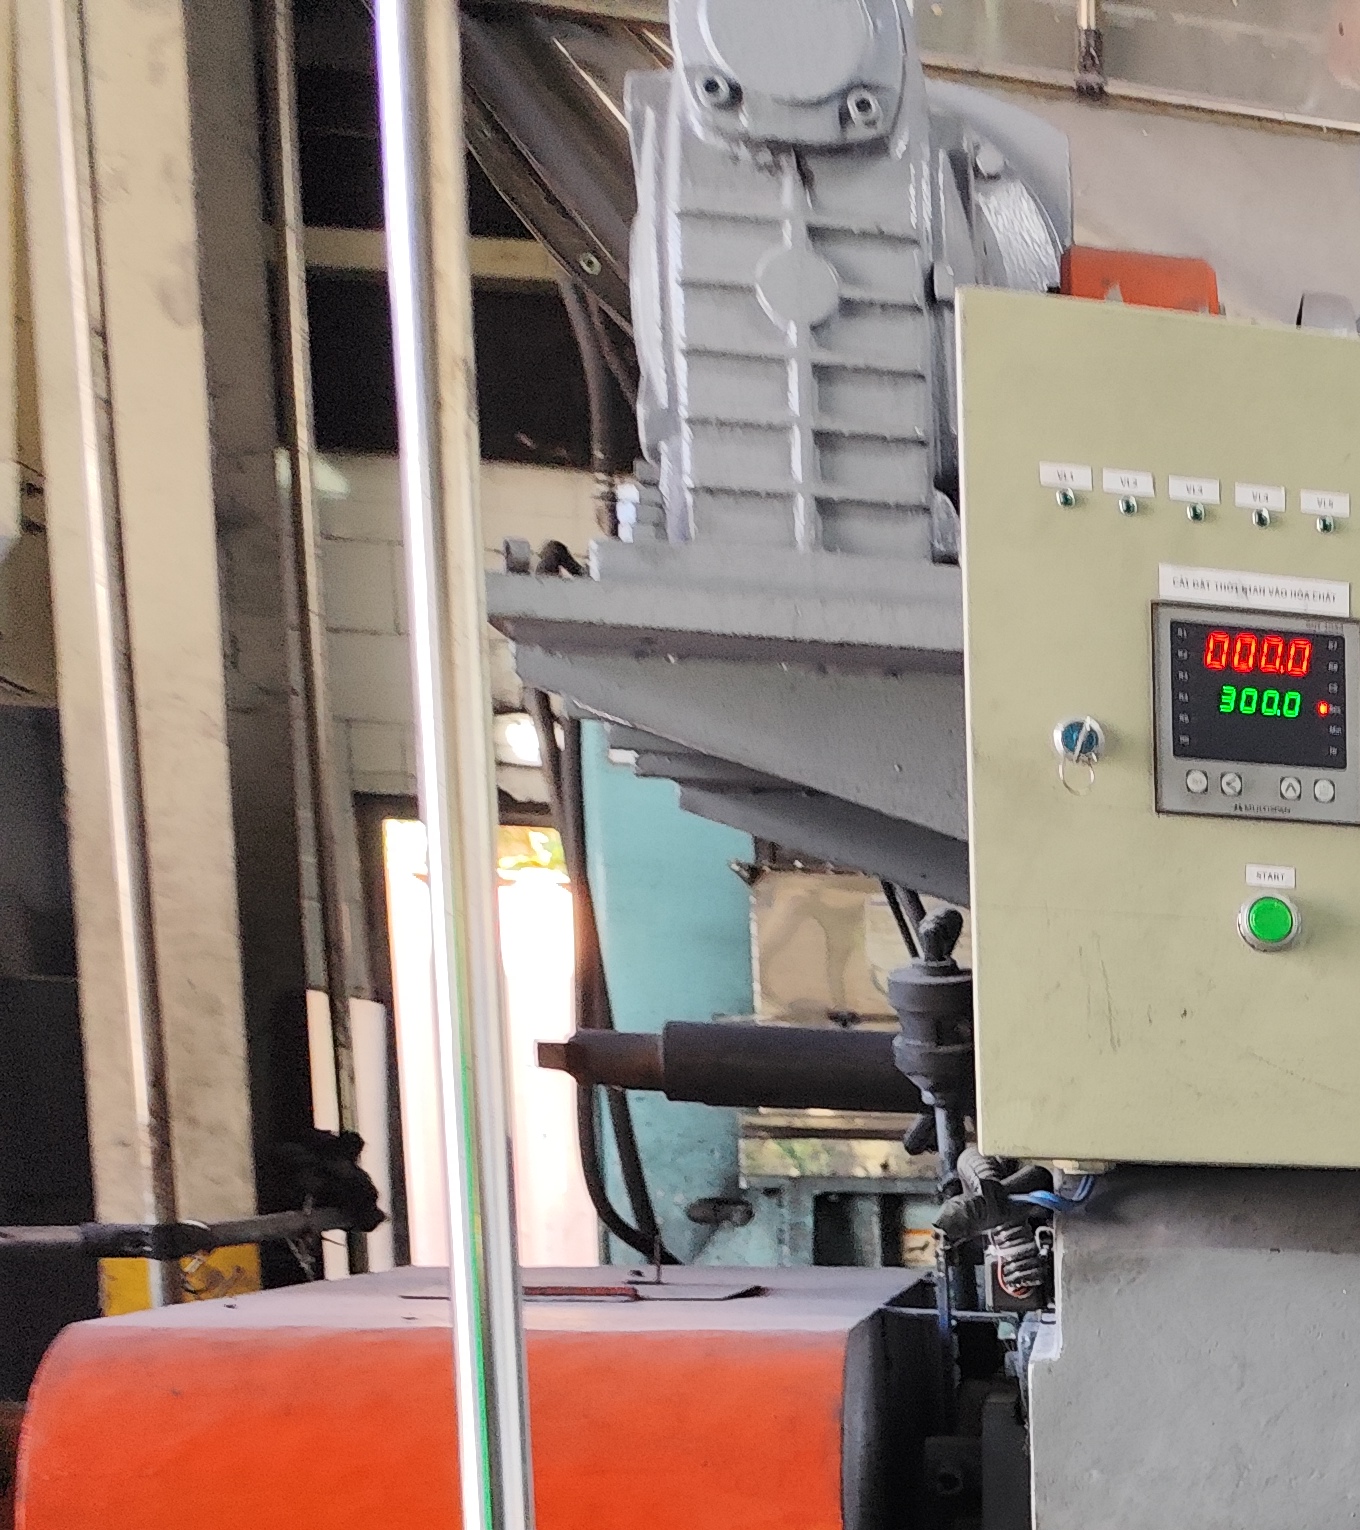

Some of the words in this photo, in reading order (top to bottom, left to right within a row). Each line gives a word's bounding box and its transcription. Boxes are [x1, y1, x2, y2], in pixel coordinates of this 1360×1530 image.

[1204, 630, 1313, 677] 000.0
[1219, 684, 1302, 718] 300.0
[1256, 871, 1285, 882] START
